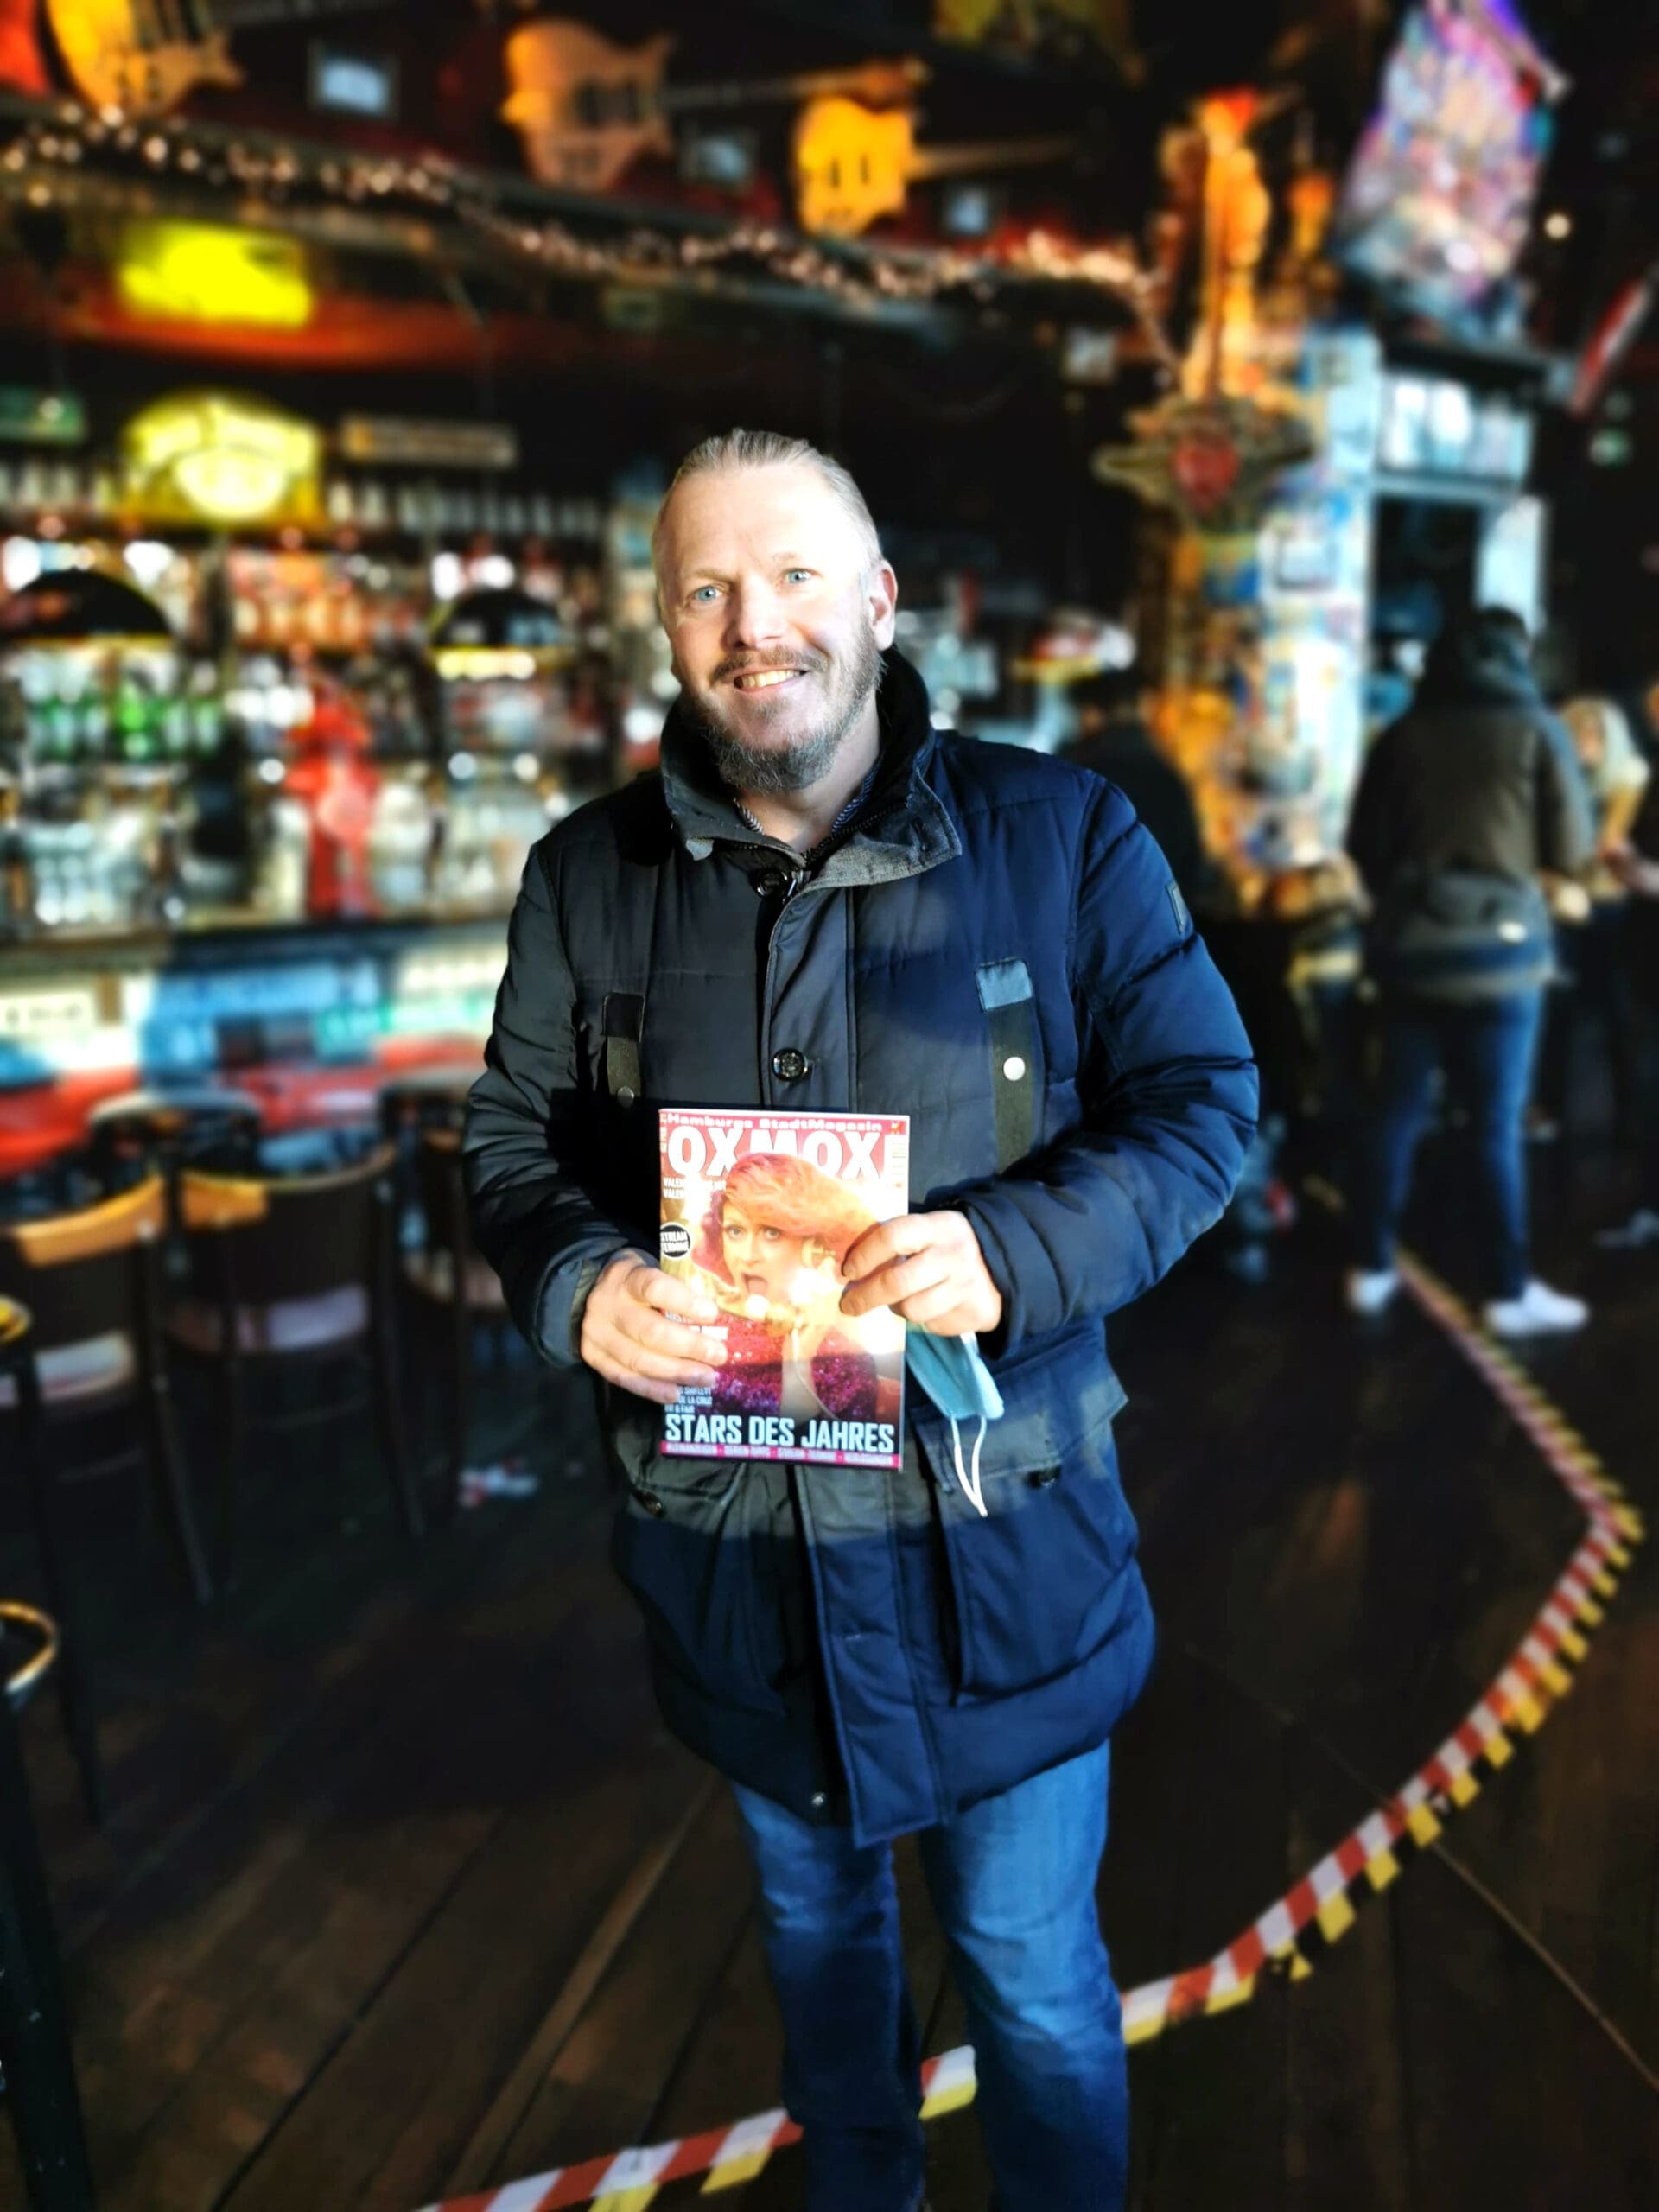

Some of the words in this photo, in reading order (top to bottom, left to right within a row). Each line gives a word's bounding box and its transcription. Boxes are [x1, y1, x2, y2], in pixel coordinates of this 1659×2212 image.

[664, 1414, 743, 1445] STARS
[748, 1415, 795, 1447] DES
[800, 1419, 895, 1454] JAHRES
